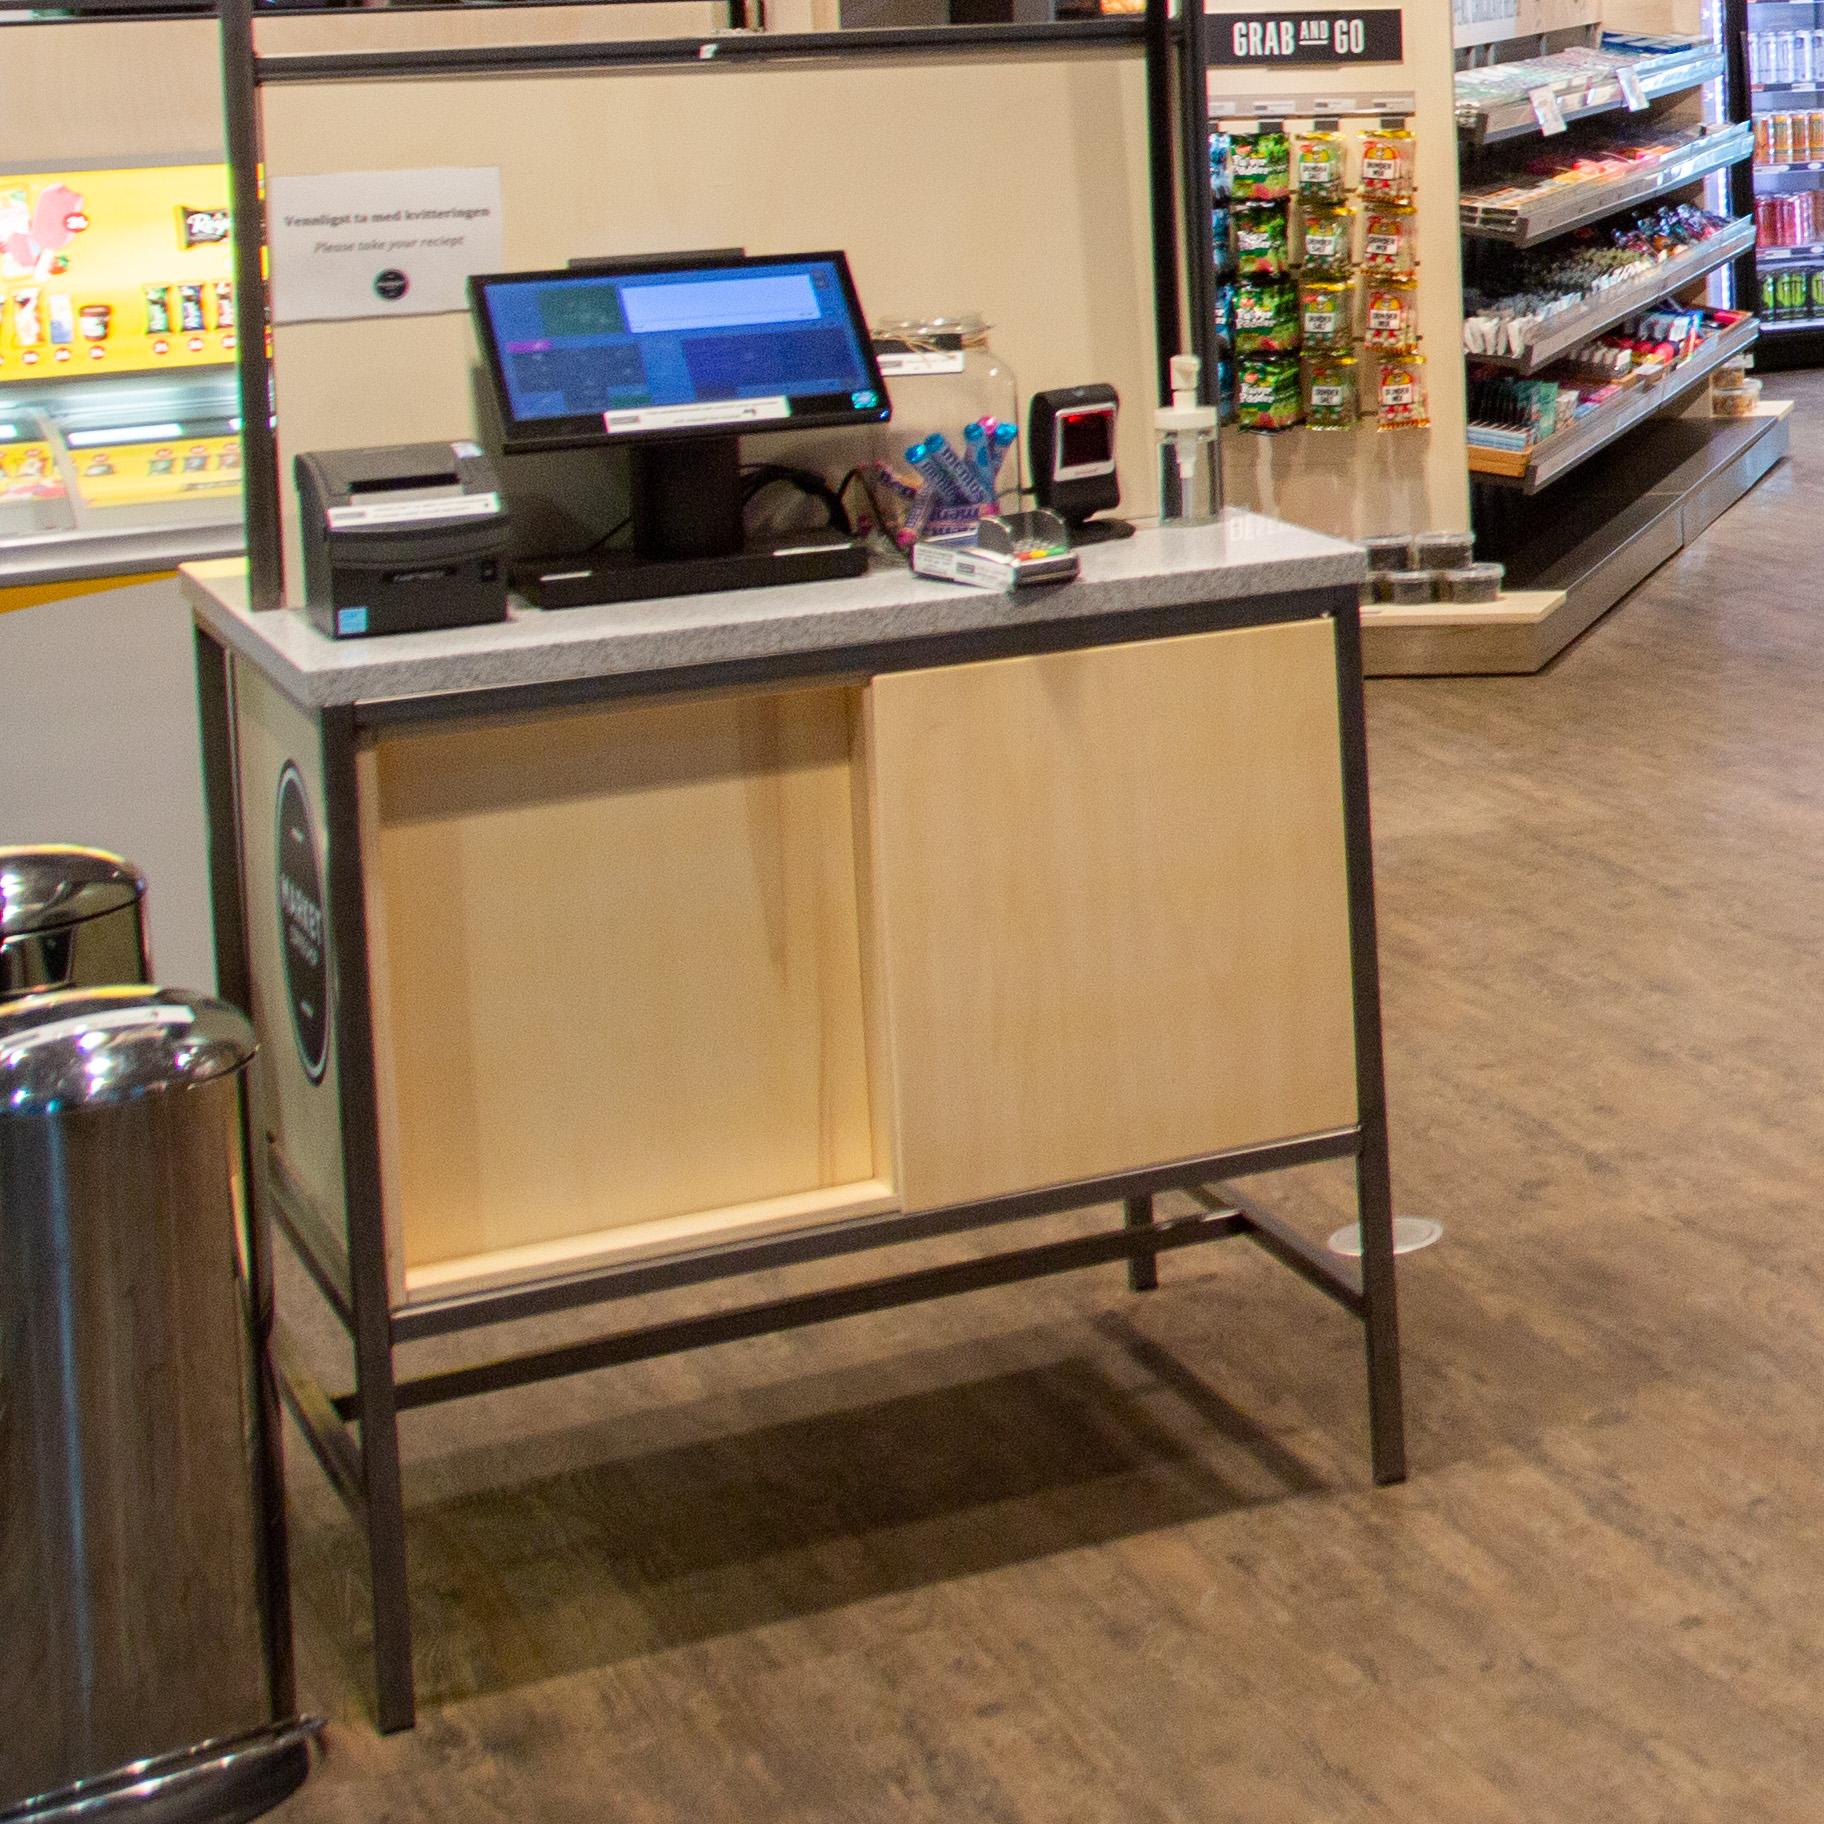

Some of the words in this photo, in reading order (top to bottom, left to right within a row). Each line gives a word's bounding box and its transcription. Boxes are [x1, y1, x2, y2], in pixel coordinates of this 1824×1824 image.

[1233, 20, 1295, 57] GRAB
[1300, 19, 1328, 41] AND
[1334, 18, 1364, 55] GO
[284, 214, 350, 227] Vennligst
[355, 213, 367, 224] ta
[372, 210, 401, 223] med
